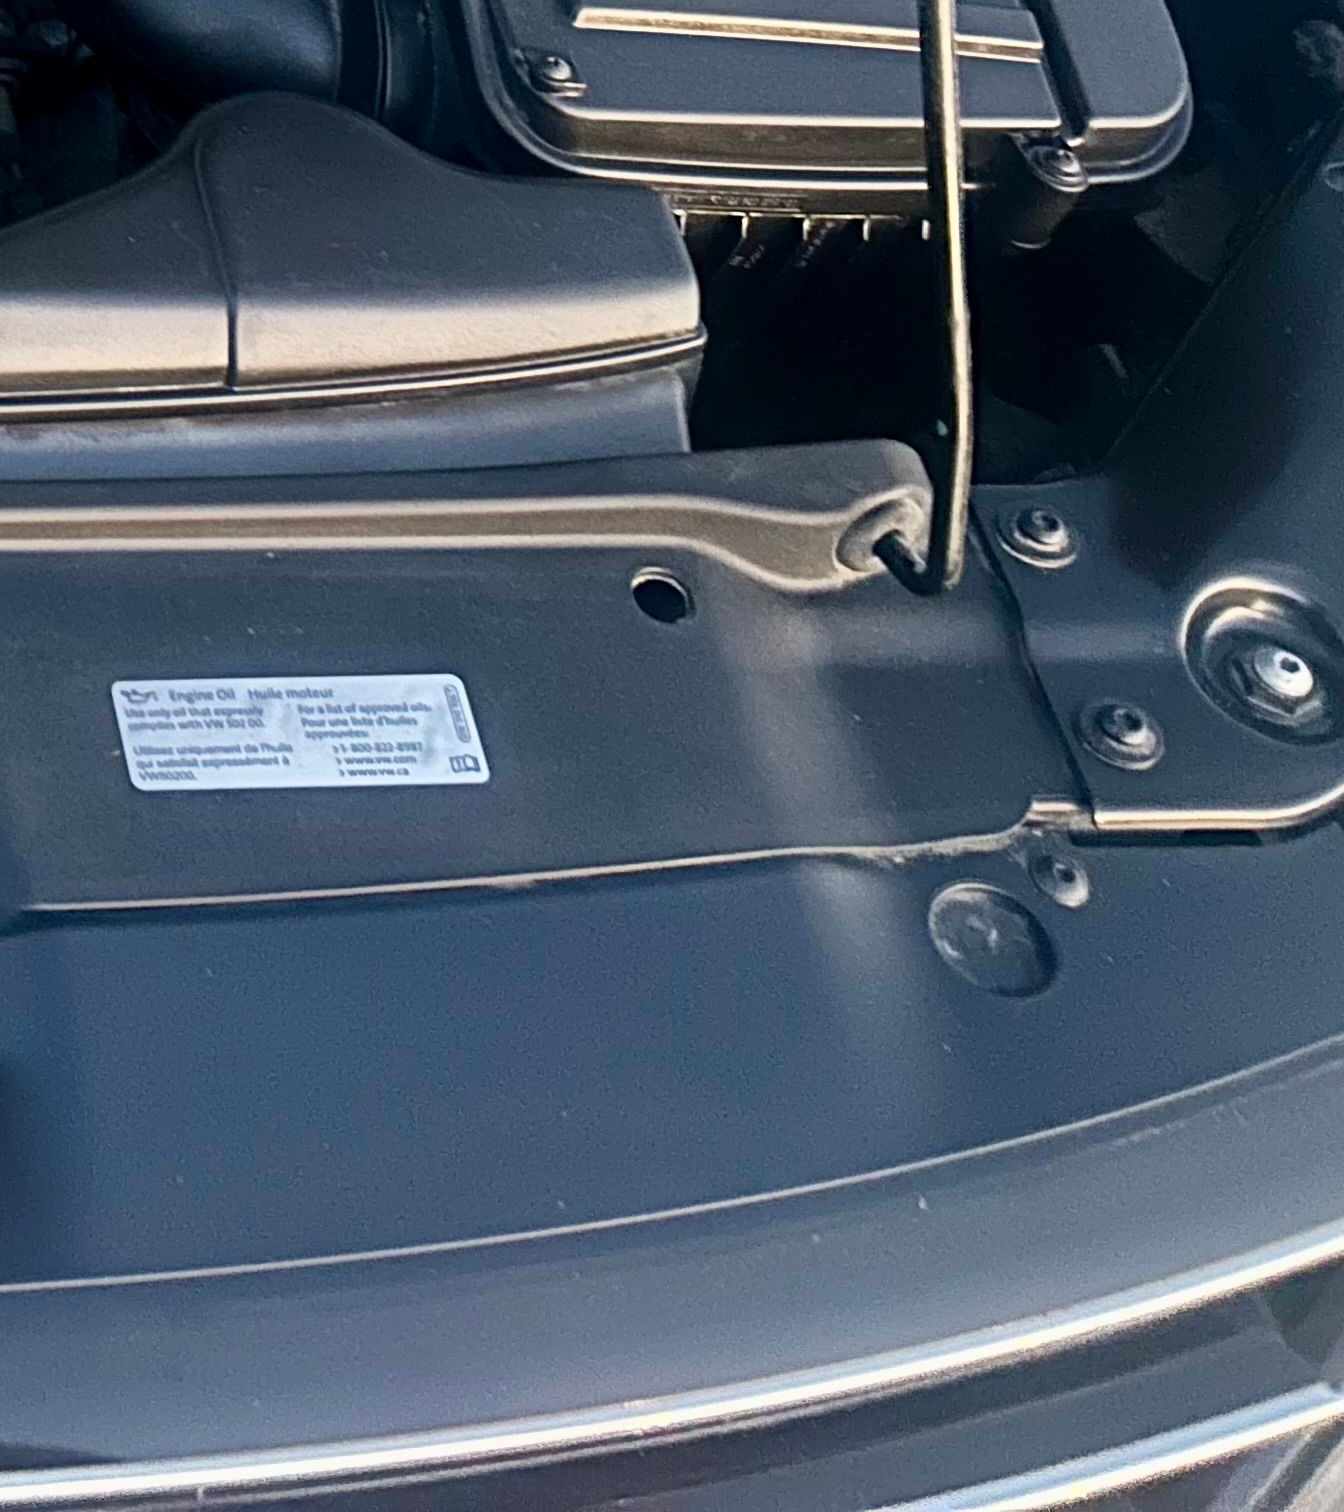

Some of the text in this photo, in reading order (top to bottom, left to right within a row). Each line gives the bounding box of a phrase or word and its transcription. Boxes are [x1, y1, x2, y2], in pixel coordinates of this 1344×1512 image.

[168, 688, 236, 704] Engine Oil
[248, 687, 334, 700] Huile moteur
[188, 707, 212, 717] that
[297, 704, 314, 714] For
[326, 703, 342, 714] list
[344, 703, 356, 713] of
[359, 702, 409, 715] approved
[177, 719, 203, 729] with
[205, 719, 224, 729] VW
[344, 755, 417, 765] www.vw.com
[347, 768, 409, 776] www.vw.ca
